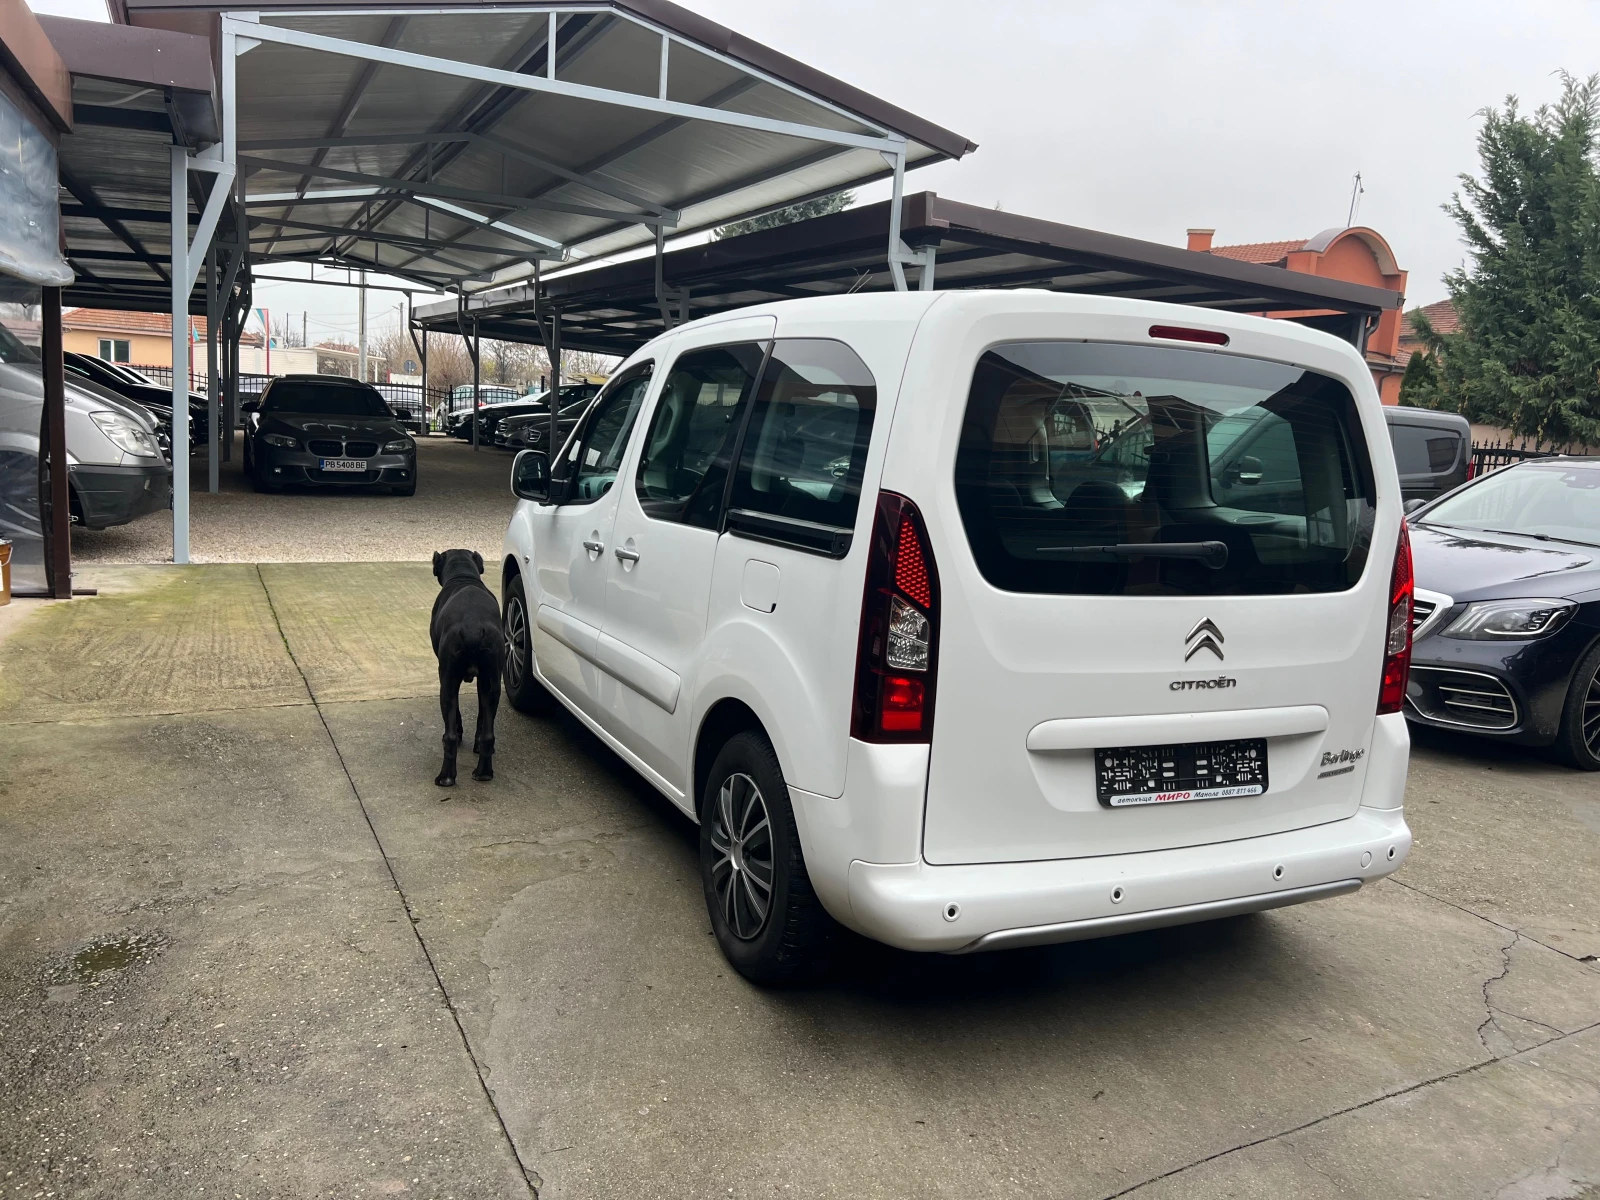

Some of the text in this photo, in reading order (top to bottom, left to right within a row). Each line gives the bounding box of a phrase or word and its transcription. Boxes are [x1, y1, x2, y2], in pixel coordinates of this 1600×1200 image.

[325, 460, 366, 469] PB 5408 BE
[1320, 748, 1365, 766] Berlingo
[1117, 796, 1152, 804] автокъща
[1155, 792, 1190, 802] МИРО
[1194, 791, 1219, 799] Маноле
